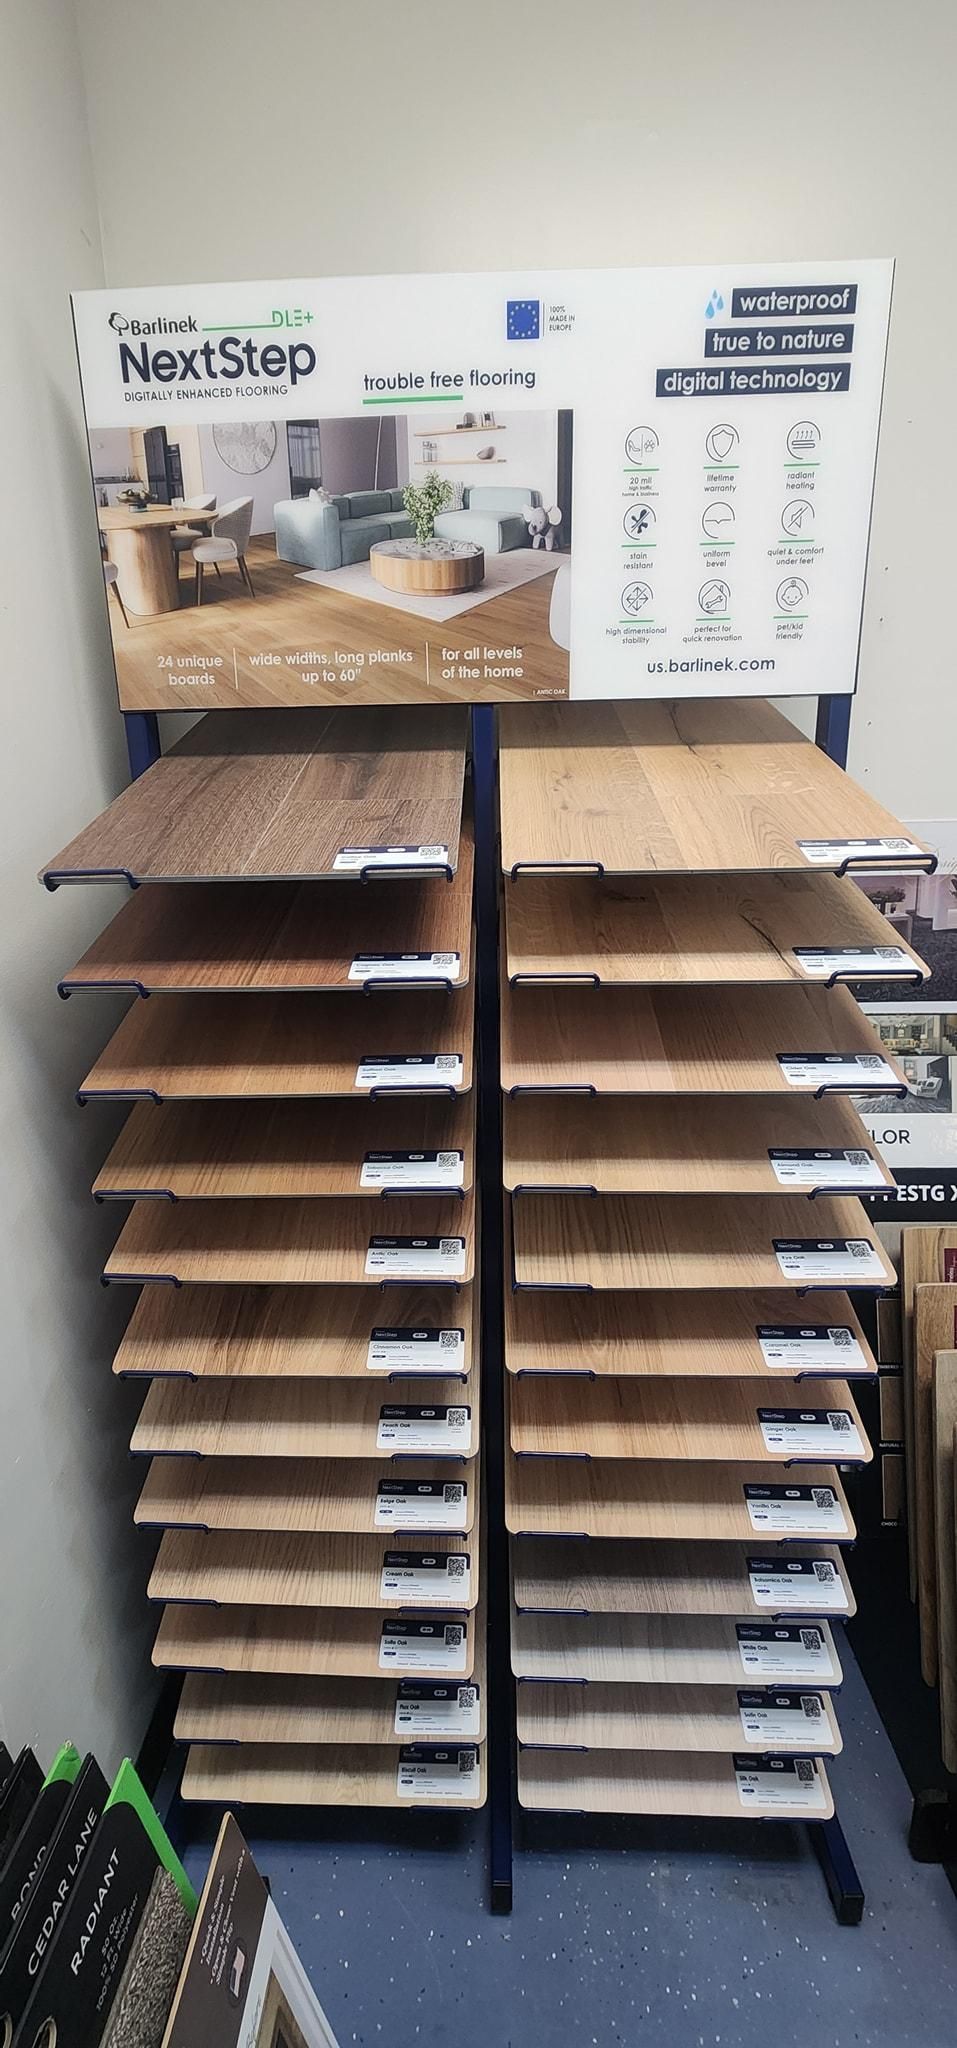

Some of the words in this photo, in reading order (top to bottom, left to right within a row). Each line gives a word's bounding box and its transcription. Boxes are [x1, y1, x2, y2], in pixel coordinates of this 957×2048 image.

[740, 288, 851, 314] waterproof
[131, 315, 198, 336] Barlinek
[549, 323, 573, 331] EUROPE
[713, 332, 750, 352] true
[756, 331, 775, 350] to
[781, 329, 845, 350] nature
[119, 337, 316, 386] NextStep
[364, 372, 424, 391] trouble
[430, 370, 464, 388] free
[469, 368, 536, 388] flooring
[664, 371, 724, 395] digital
[730, 368, 843, 391] technology
[124, 390, 172, 403] DIGITALLY
[177, 388, 233, 400] ENHANCED
[236, 385, 288, 397] FLOORING
[630, 477, 639, 485] 20
[787, 472, 815, 480] radiant
[704, 485, 737, 494] warranty
[786, 482, 815, 491] heating
[703, 550, 731, 558] uniform
[767, 548, 786, 557] quiet
[794, 547, 824, 555] comfort
[623, 562, 653, 570] resistant
[706, 559, 727, 568] bevel
[776, 558, 798, 566] under
[799, 557, 814, 565] feet
[606, 628, 621, 636] high
[623, 627, 667, 635] dimensional
[694, 625, 720, 634] perfect
[721, 625, 731, 633] for
[777, 623, 803, 632] pet/kid
[622, 636, 650, 645] stability
[682, 635, 702, 644] quick
[703, 634, 742, 642] renovation
[775, 632, 803, 641] friendly
[249, 653, 281, 666] wide
[285, 651, 331, 666] widths,
[335, 650, 365, 665] long
[368, 649, 413, 663] planks
[442, 648, 460, 660] for
[463, 647, 480, 659] all
[483, 646, 522, 659] levels
[157, 656, 174, 668] 24
[177, 655, 223, 669] unique
[647, 657, 775, 674] us.barlinek.com
[302, 672, 320, 684] up
[322, 670, 337, 682] to
[442, 666, 455, 678] of
[458, 666, 481, 678] the
[484, 665, 523, 678] home
[168, 673, 215, 685] boards
[867, 1130, 911, 1145] LOR
[27, 1879, 70, 1975] CEDAR
[68, 1806, 98, 1876] LANE
[69, 1847, 121, 1976] RADIANT
